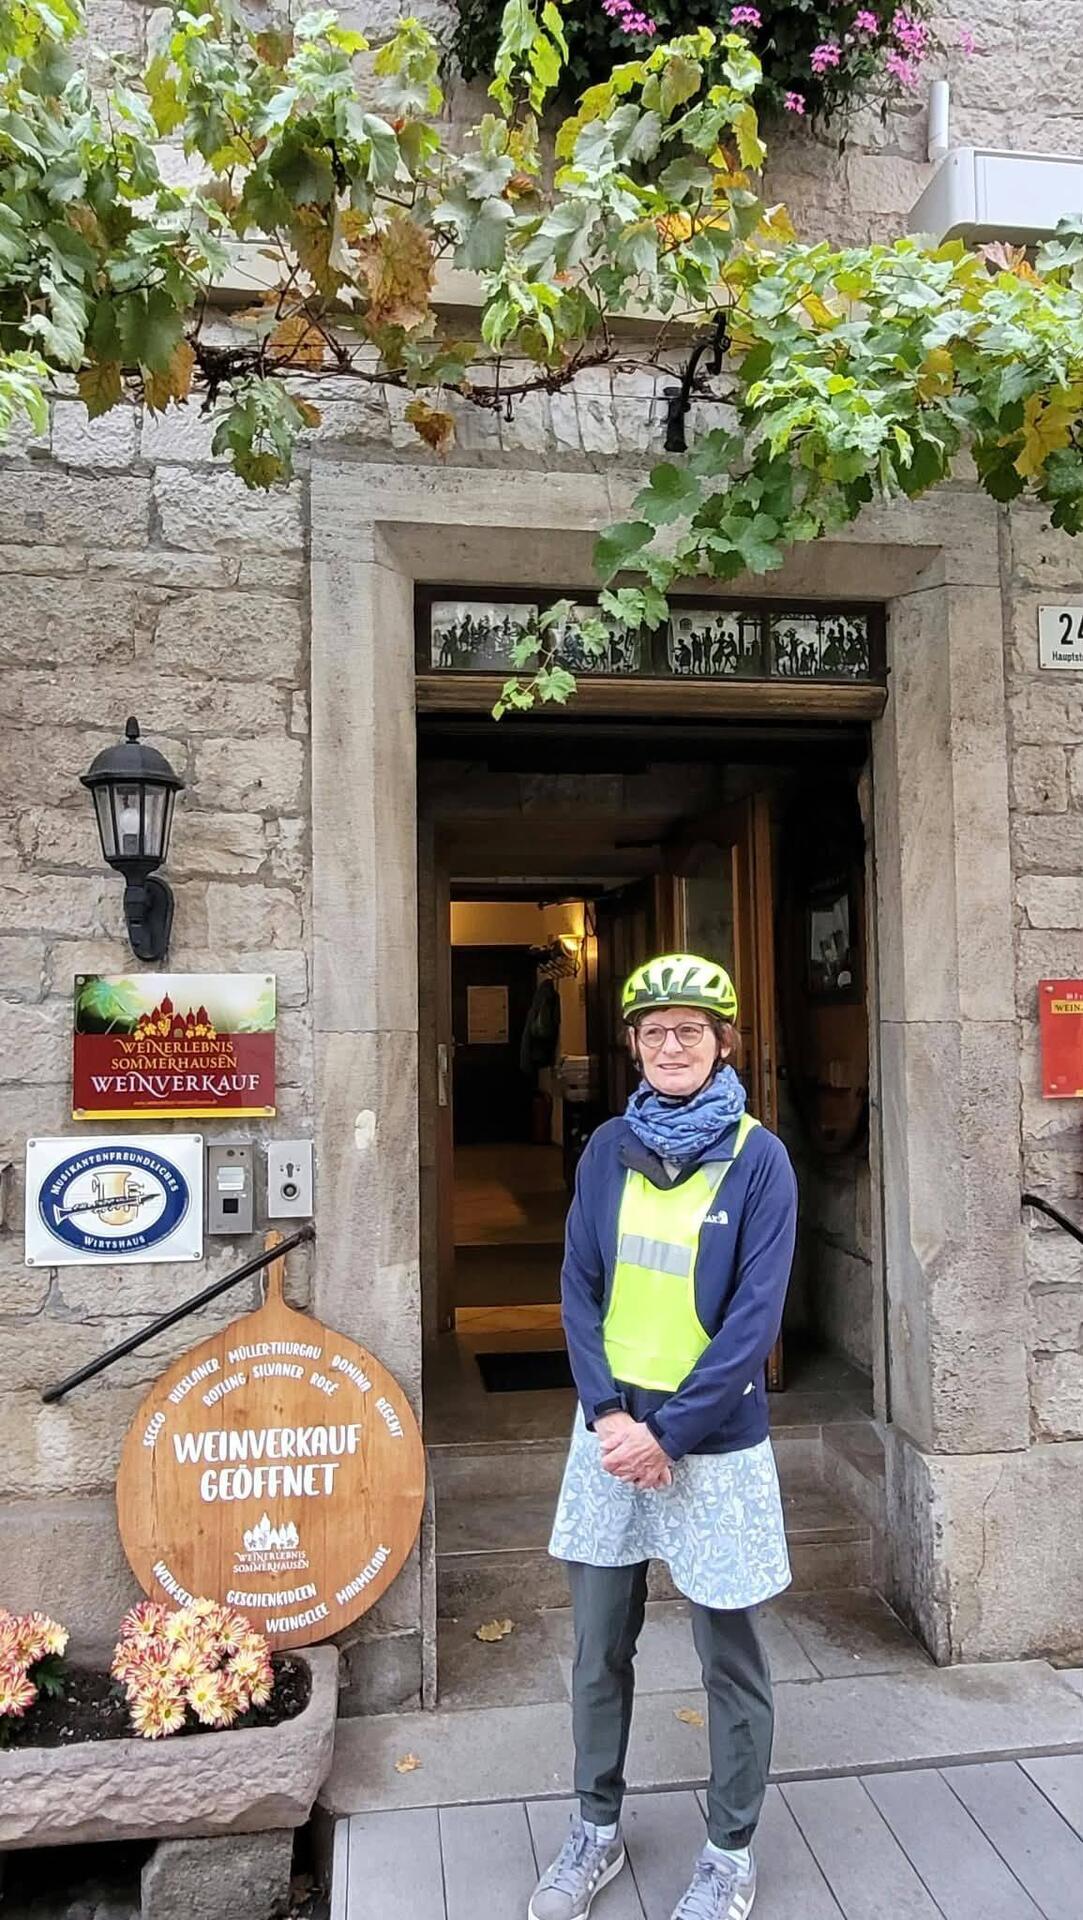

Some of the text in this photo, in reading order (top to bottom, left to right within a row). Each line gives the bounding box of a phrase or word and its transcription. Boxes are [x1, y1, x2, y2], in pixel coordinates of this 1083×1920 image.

[1052, 651, 1083, 662] Hauptst
[114, 1039, 233, 1057] WEINERLEBNIS
[111, 1054, 237, 1072] SOMMERHAUSEN
[90, 1071, 260, 1098] WEINVERKAUF
[50, 1152, 179, 1195] MUSIKANTENFREUNDLICHES
[84, 1235, 146, 1249] WIRTSHAUS
[202, 1372, 247, 1407] ROTLING
[252, 1362, 305, 1379] SILVANER
[143, 1412, 166, 1447] SECCO
[168, 1358, 221, 1404] RIESLANER
[331, 1354, 372, 1393] DOMINA
[374, 1397, 403, 1439] REGENT
[173, 1423, 362, 1464] WEINVERKAUF
[200, 1463, 340, 1502] GEÖFFNET
[232, 1559, 310, 1574] SOMMERHAUSEN
[234, 1550, 306, 1563] WEINERLEBNIS
[153, 1543, 391, 1633] WEIN-SEN WEINGELEE MARMELADE
[226, 1582, 317, 1607] GESCHENKIDEEN
